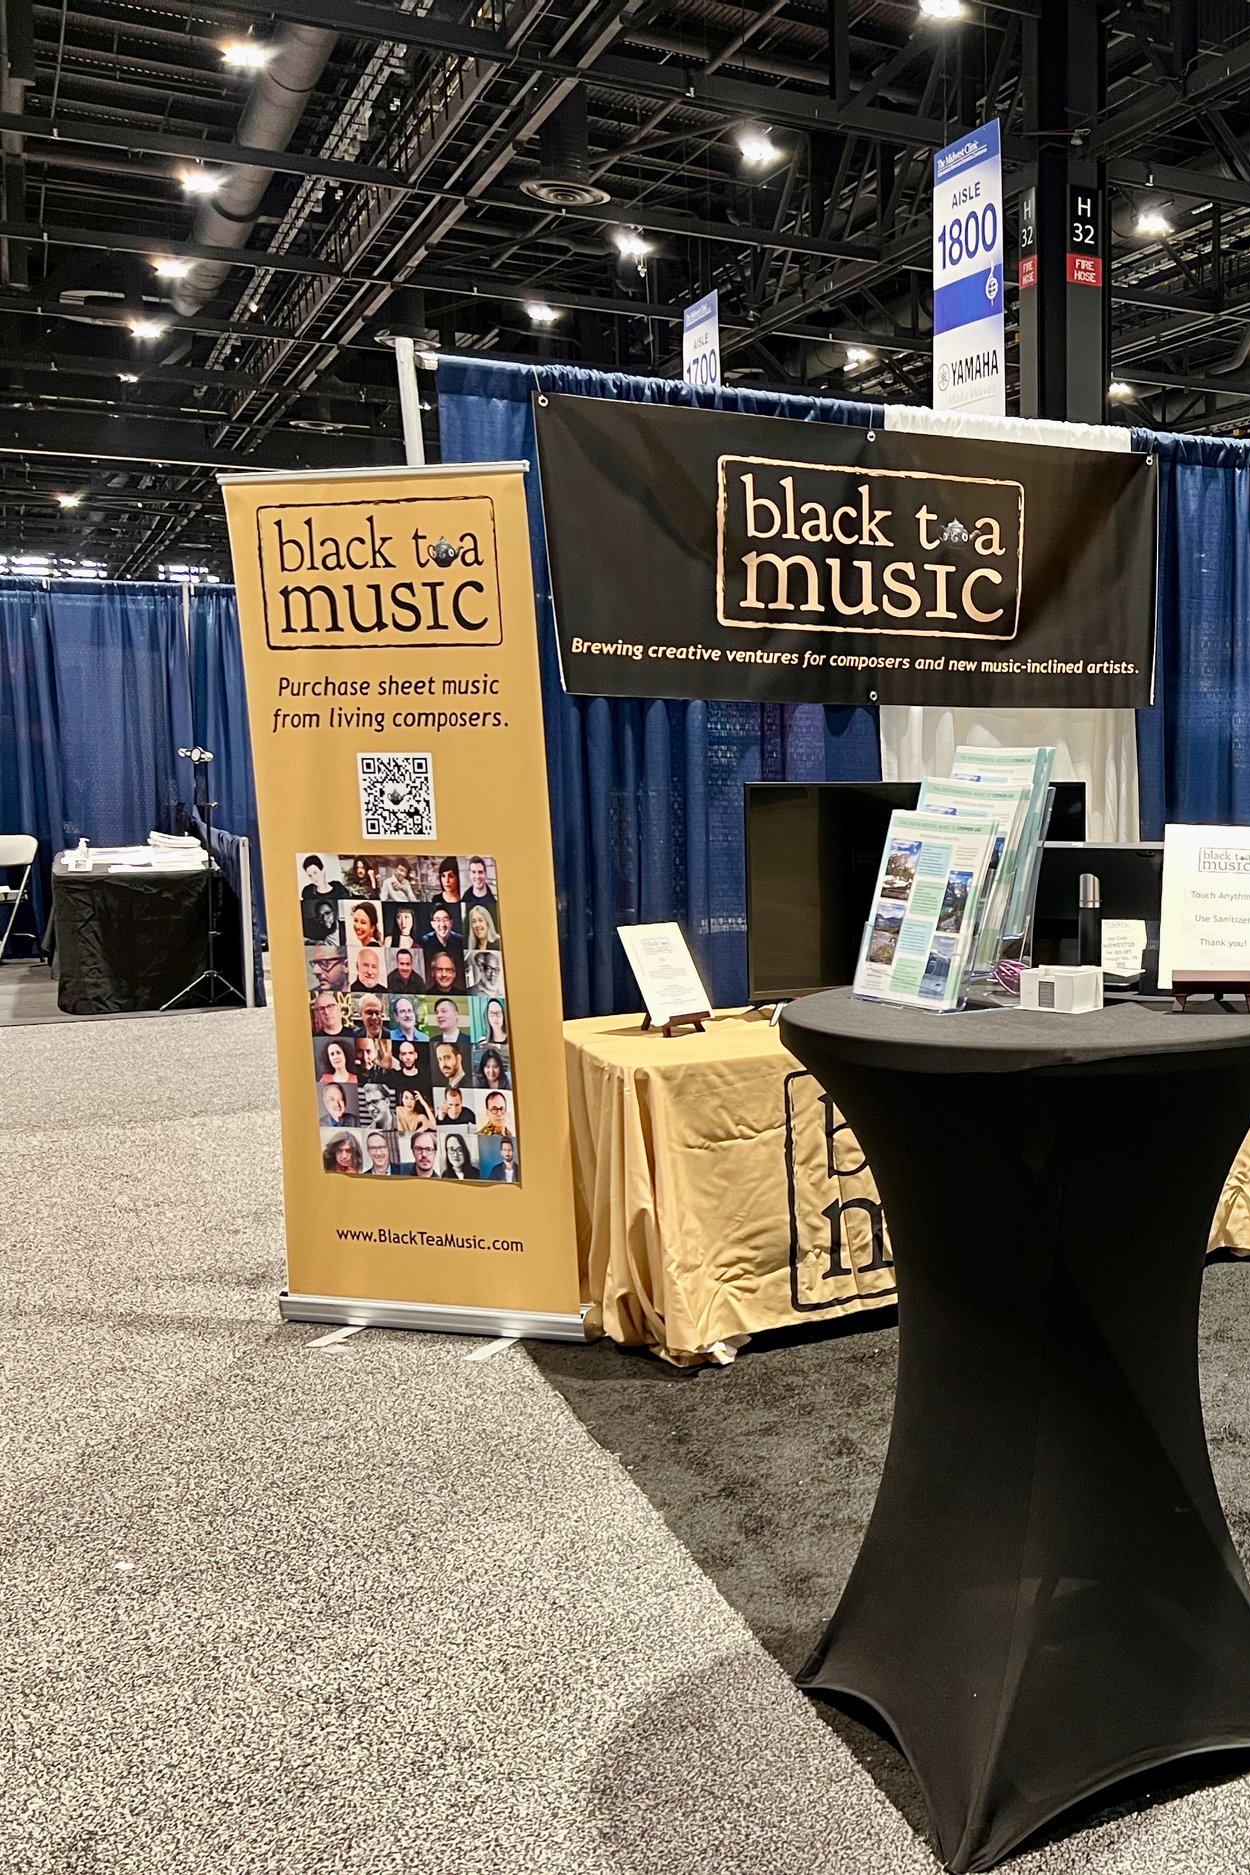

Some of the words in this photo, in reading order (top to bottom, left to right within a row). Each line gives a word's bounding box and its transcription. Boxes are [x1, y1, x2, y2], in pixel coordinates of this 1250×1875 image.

[951, 181, 981, 209] AISLE
[1023, 200, 1032, 220] H
[1077, 196, 1091, 218] H
[937, 203, 998, 269] 1800
[1021, 225, 1034, 248] 32
[1072, 222, 1095, 245] 32
[1022, 260, 1034, 274] FIRE
[1073, 269, 1097, 283] HOSE
[1075, 258, 1095, 271] FIRE
[693, 332, 709, 350] AISLE
[686, 349, 718, 386] 1700
[951, 349, 999, 386] YAMAHA
[740, 472, 894, 548] black
[273, 514, 396, 573] black
[738, 549, 1004, 623] music
[278, 579, 489, 634] music
[571, 637, 644, 661] Brewing
[647, 642, 721, 662] creative
[726, 650, 799, 665] ventures
[802, 650, 827, 668] for
[829, 652, 910, 672] composers
[914, 655, 944, 672] and
[947, 659, 977, 673] new
[980, 657, 1083, 675] music-inclined
[1086, 660, 1140, 676] artists.
[278, 675, 370, 698] Purchase
[378, 675, 435, 696] sheet
[442, 674, 500, 696] music
[272, 707, 321, 733] from
[329, 707, 386, 733] living
[392, 708, 510, 733] composers.
[1203, 849, 1231, 861] black
[1191, 890, 1216, 900] Touch
[1195, 914, 1211, 922] Use
[1199, 937, 1226, 947] Thank
[1228, 939, 1248, 949] you!
[336, 1227, 524, 1254] www.BlackTeaMusic.com
